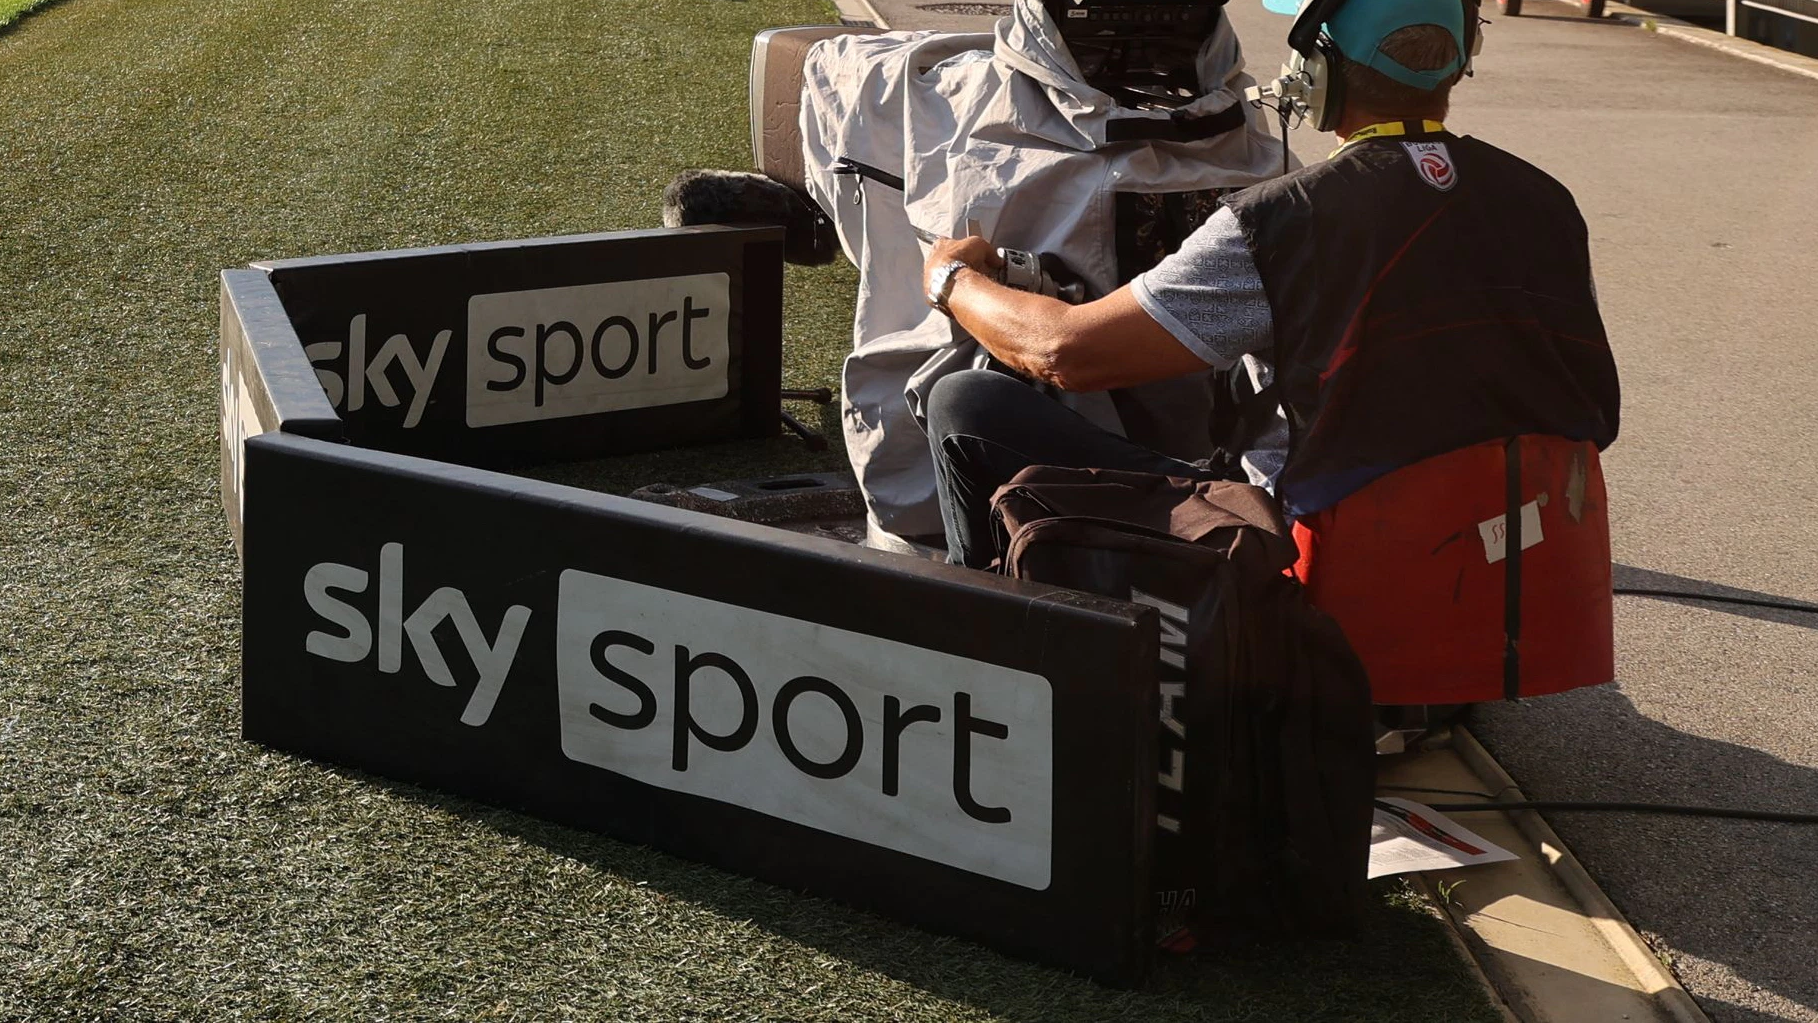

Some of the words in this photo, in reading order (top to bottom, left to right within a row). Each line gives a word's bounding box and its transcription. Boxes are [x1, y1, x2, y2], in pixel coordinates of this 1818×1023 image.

[307, 313, 452, 429] sky
[486, 295, 711, 407] sport
[304, 542, 533, 727] sky
[588, 629, 1011, 824] sport
